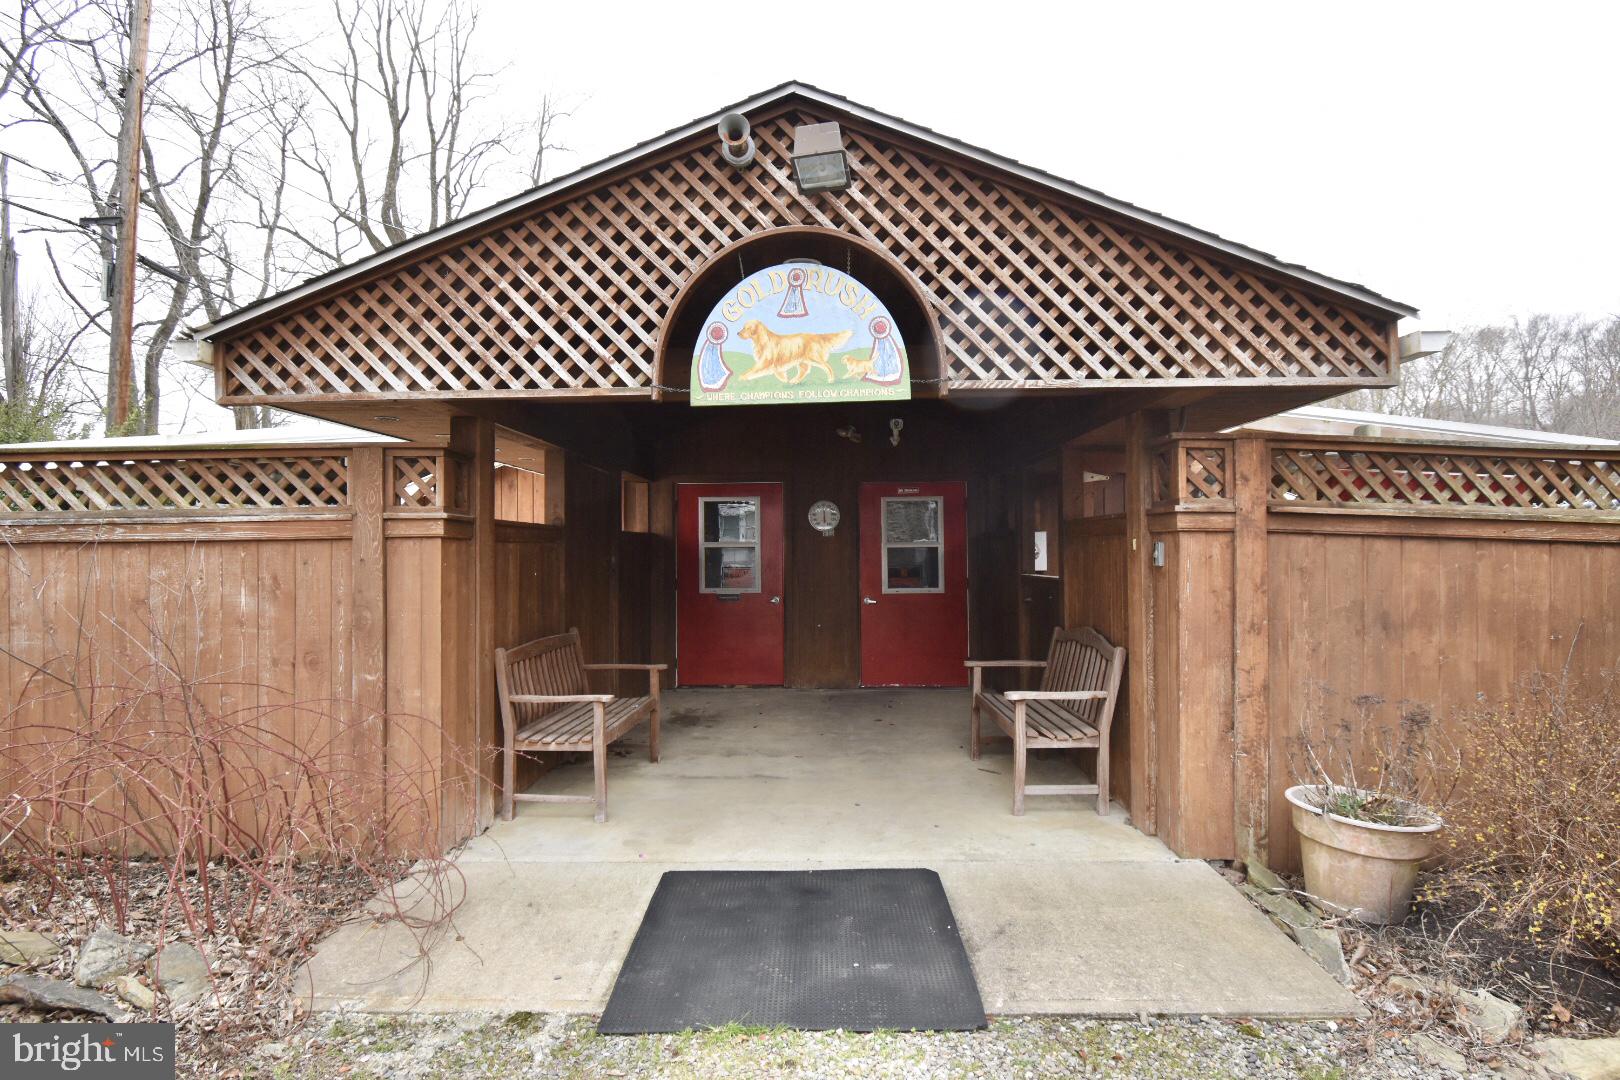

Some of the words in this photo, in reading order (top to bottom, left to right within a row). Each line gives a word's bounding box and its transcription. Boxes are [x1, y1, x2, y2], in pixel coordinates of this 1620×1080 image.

[721, 270, 789, 322] GOLD
[805, 269, 878, 320] RUSH
[707, 392, 736, 401] WHERE
[740, 390, 794, 400] CHAMPIONS
[799, 389, 837, 398] FOLLOW
[839, 388, 895, 397] CHAMPIONS
